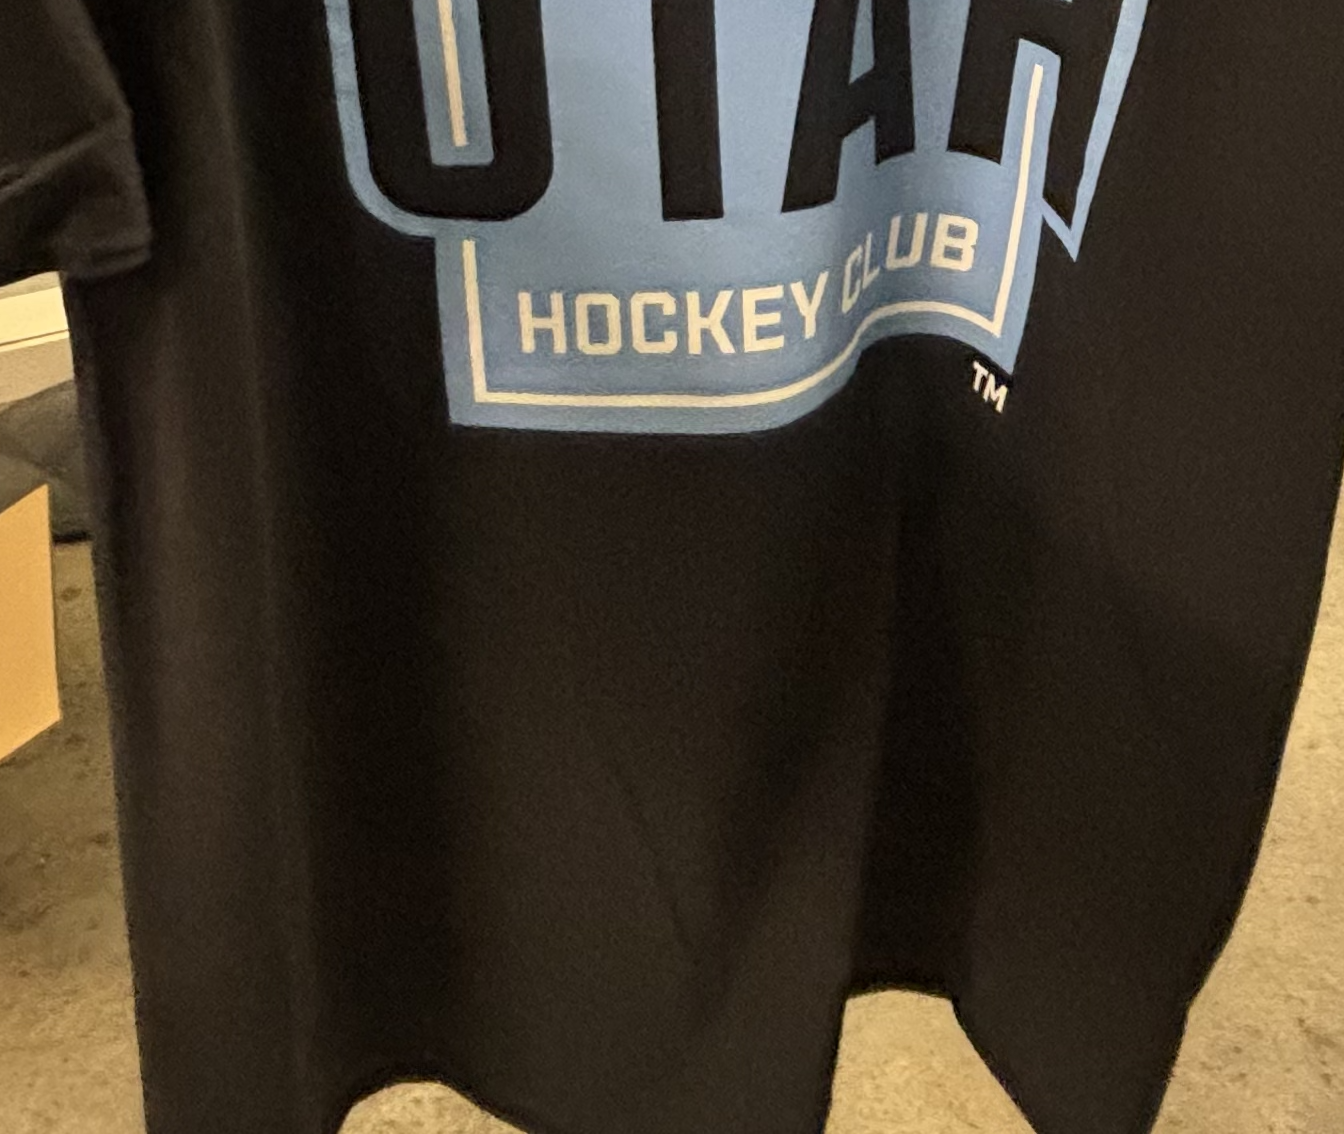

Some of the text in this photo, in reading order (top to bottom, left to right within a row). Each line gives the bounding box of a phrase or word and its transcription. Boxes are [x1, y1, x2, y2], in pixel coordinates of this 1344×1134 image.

[517, 211, 980, 356] HOCKEY CLUB
[971, 360, 1010, 415] TM
